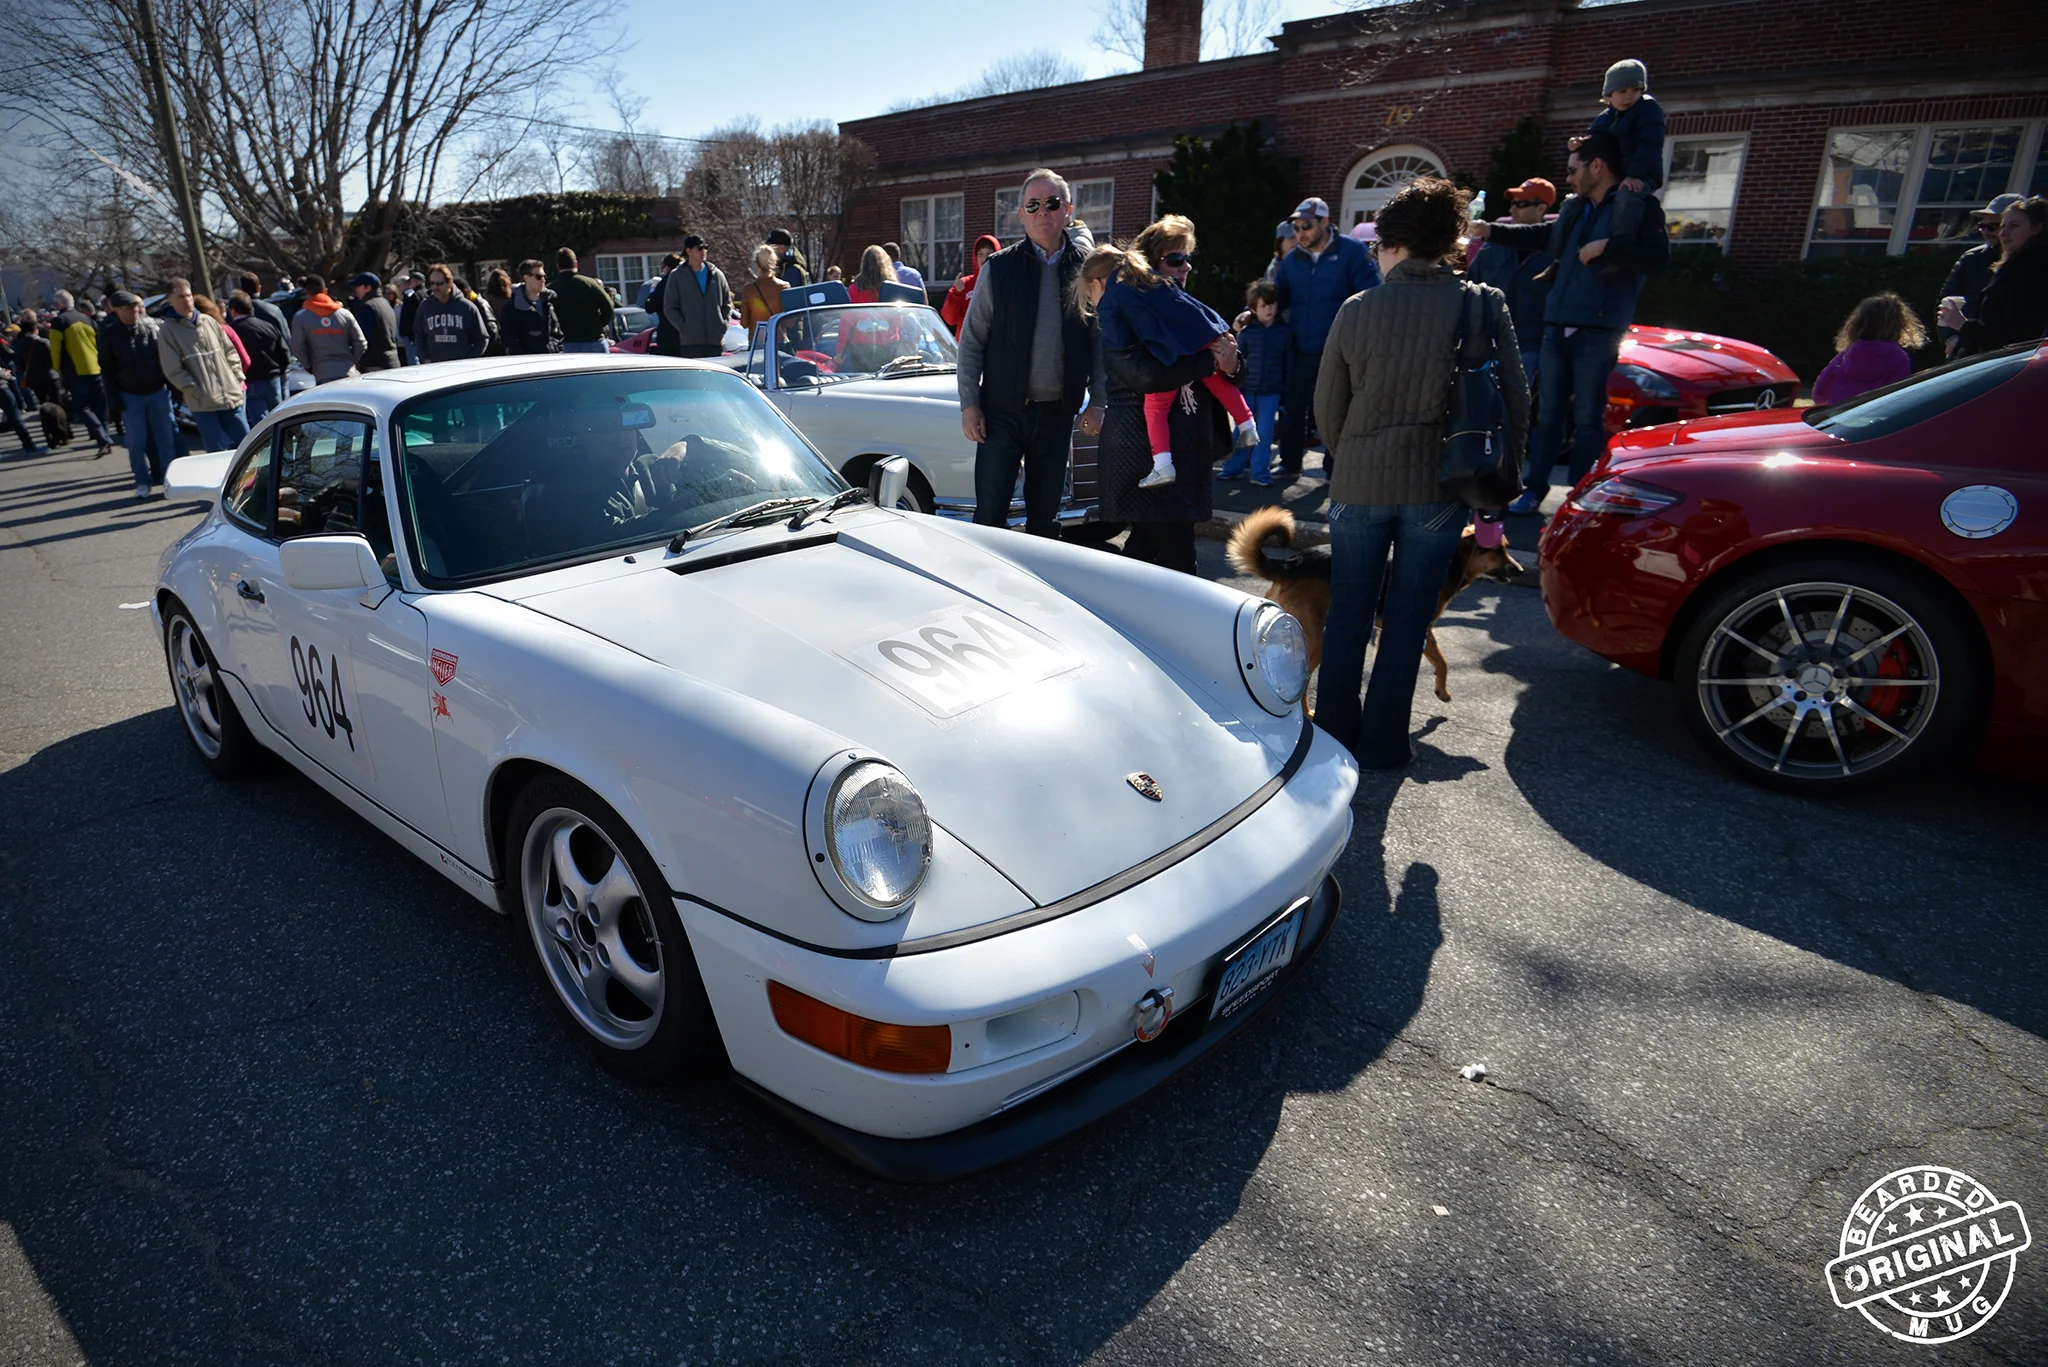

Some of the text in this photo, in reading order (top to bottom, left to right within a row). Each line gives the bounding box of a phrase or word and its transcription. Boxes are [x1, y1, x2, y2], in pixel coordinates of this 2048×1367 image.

[427, 313, 464, 331] UCONN
[435, 334, 458, 343] HUSKIES
[431, 659, 455, 682] HEUER
[877, 615, 1033, 696] 964
[290, 635, 355, 752] 964
[1221, 967, 1281, 1016] SPEEDSPORT
